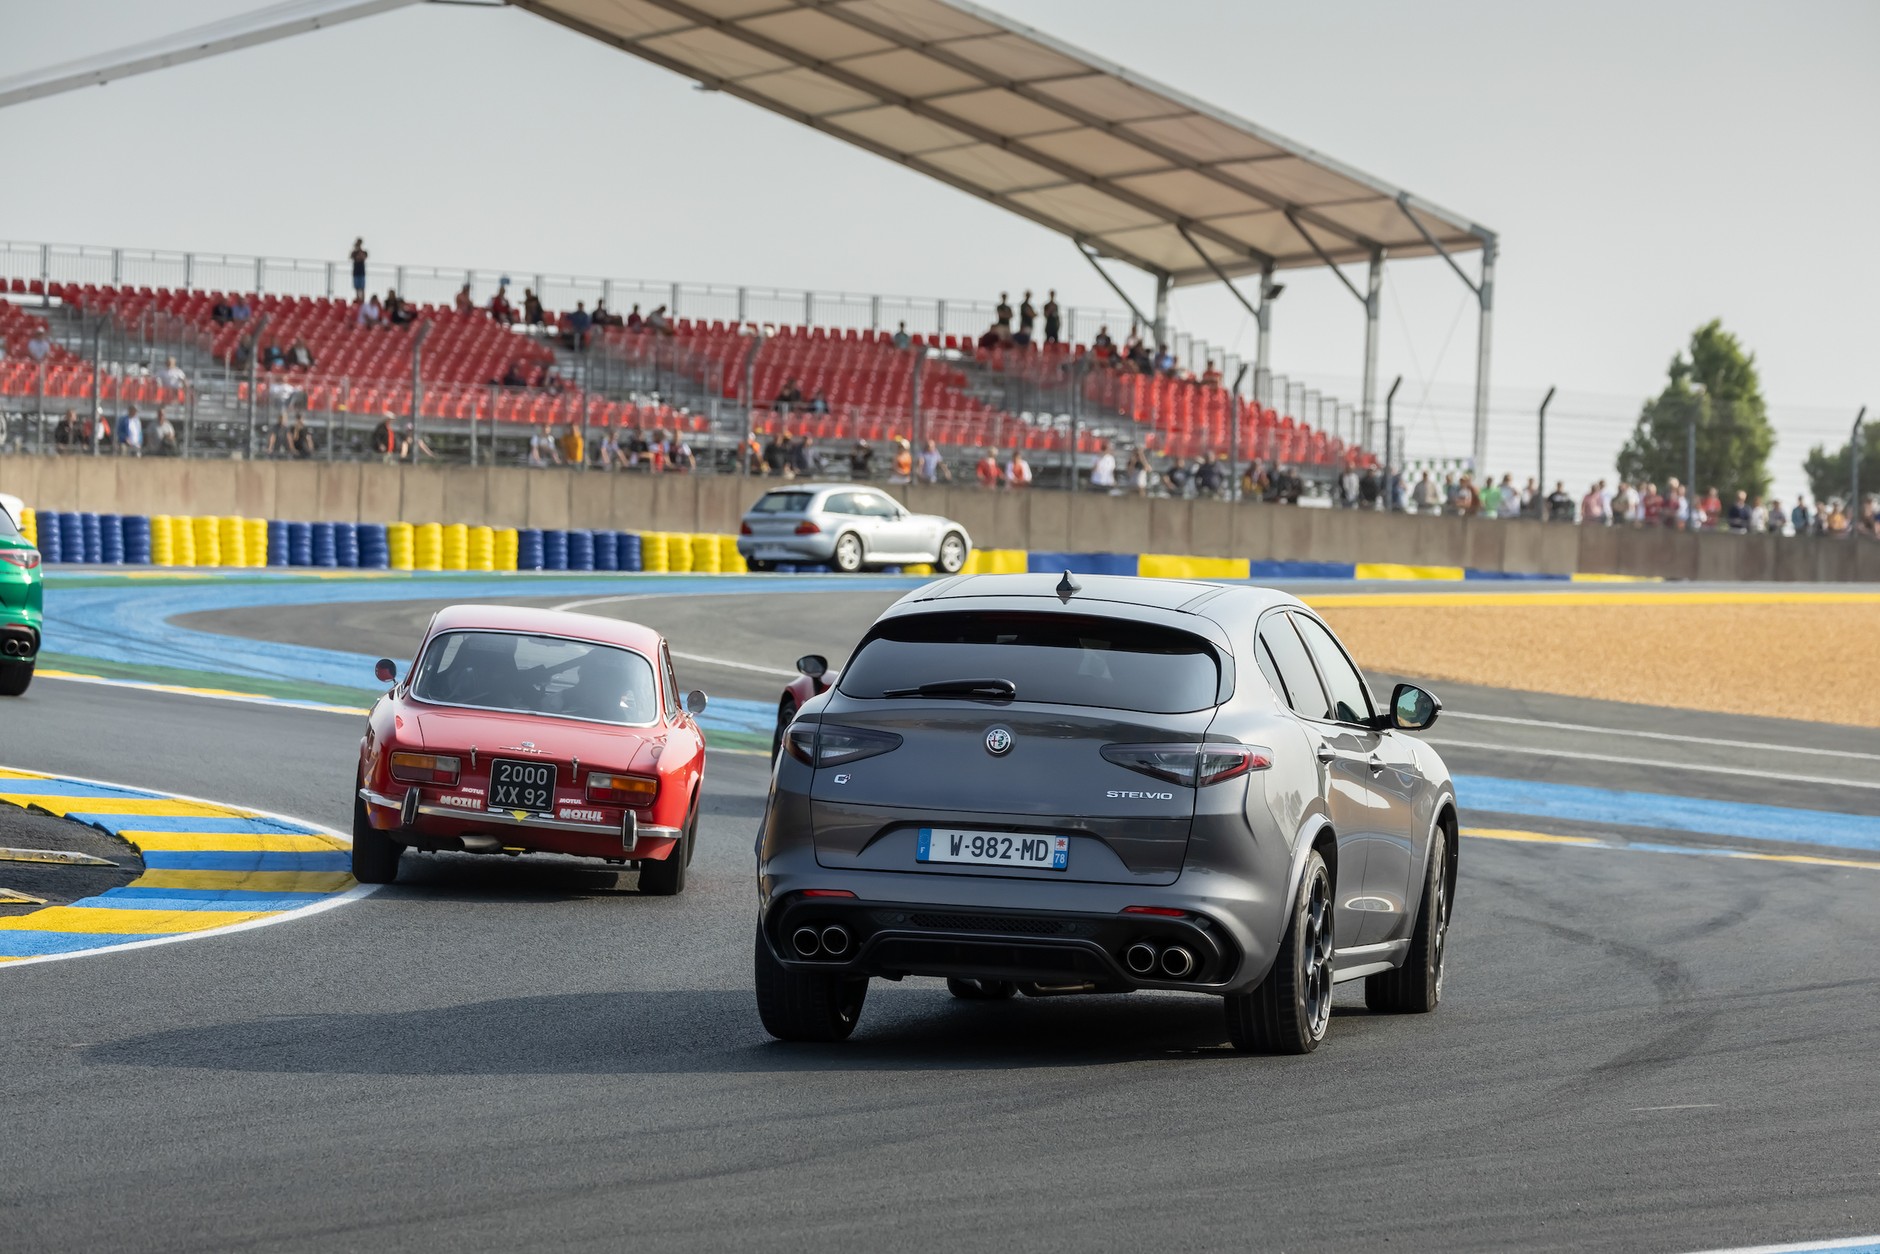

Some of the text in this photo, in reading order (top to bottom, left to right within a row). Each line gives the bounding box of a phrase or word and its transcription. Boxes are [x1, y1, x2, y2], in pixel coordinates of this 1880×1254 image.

[500, 764, 548, 785] 2000
[461, 787, 484, 795] MOTUL
[495, 785, 547, 806] XX 92
[1106, 790, 1173, 800] STELVIO
[950, 834, 1049, 861] W-982-MD
[1054, 853, 1066, 864] 78
